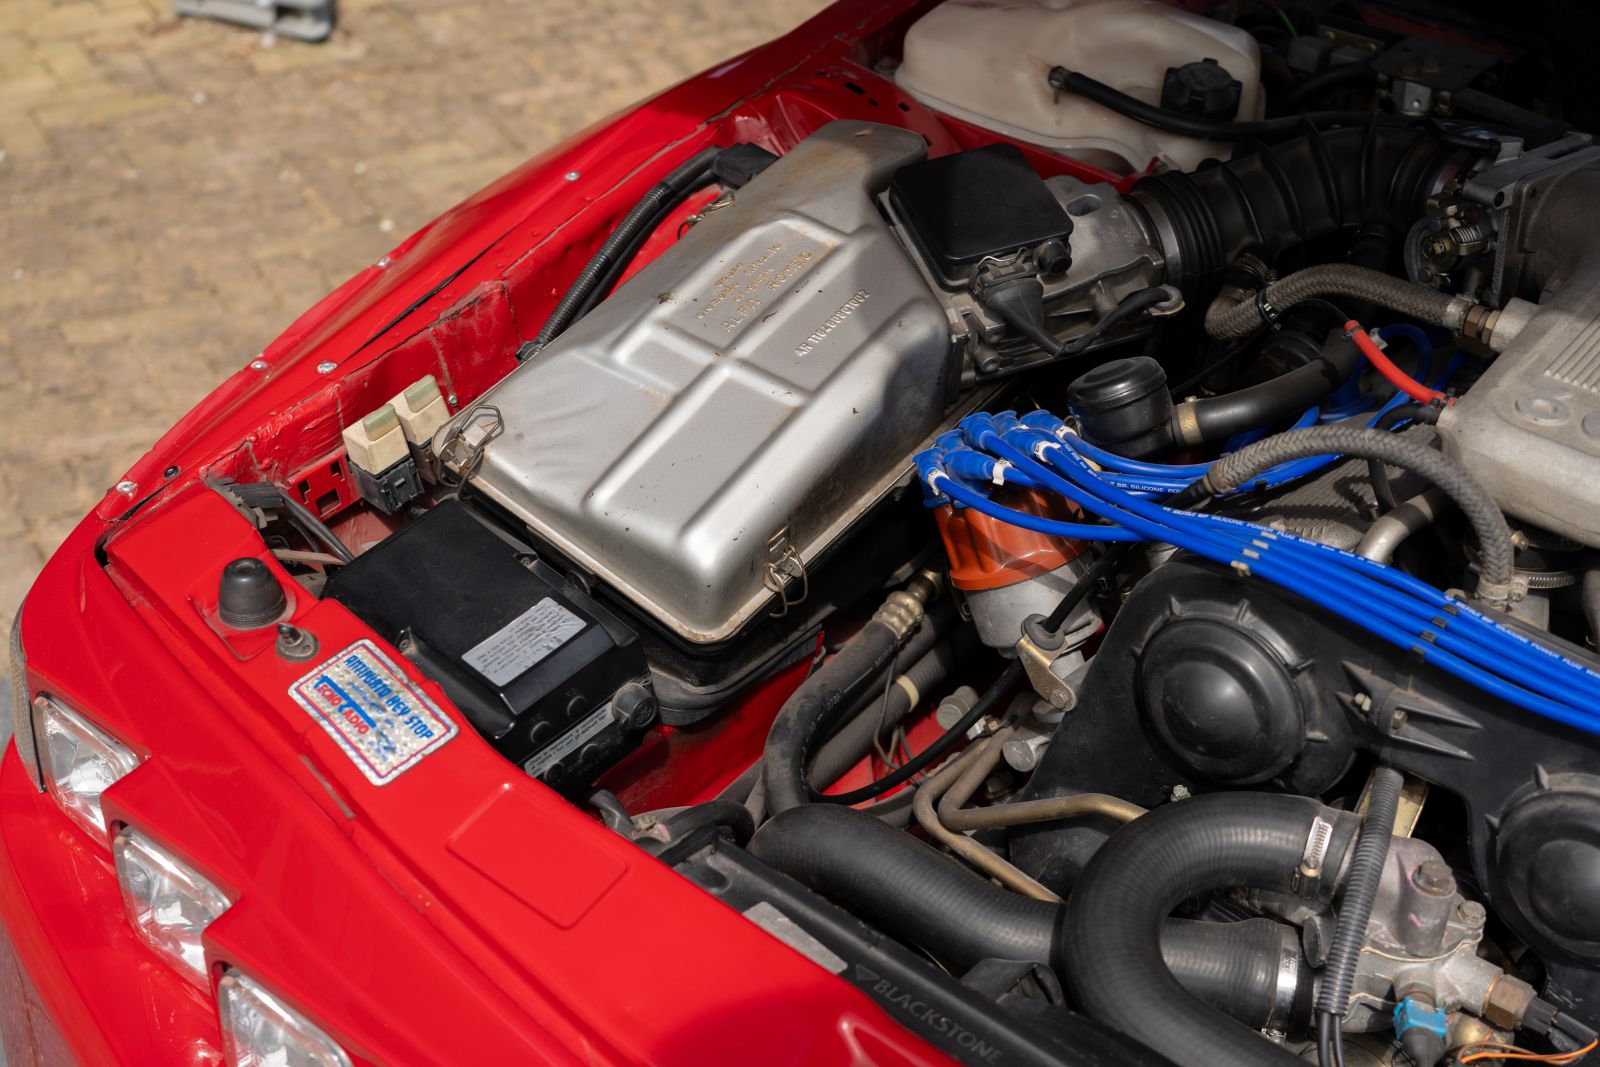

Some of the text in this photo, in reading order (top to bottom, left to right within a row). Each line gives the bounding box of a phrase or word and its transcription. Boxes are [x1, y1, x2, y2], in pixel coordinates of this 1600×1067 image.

[720, 250, 811, 332] ALFA ROMEO
[1130, 484, 1164, 492] SILICONE
[1212, 516, 1243, 526] SILICONE
[1247, 523, 1273, 532] POWER
[1276, 530, 1295, 540] PLUG
[1298, 537, 1317, 546] WIRE
[1495, 624, 1528, 643] SILICONE
[1531, 642, 1559, 658] POWER
[1562, 658, 1583, 670] PLUG
[386, 695, 411, 717] KEY
[405, 715, 434, 739] STOP
[873, 979, 1003, 1064] BLACKSTONE
